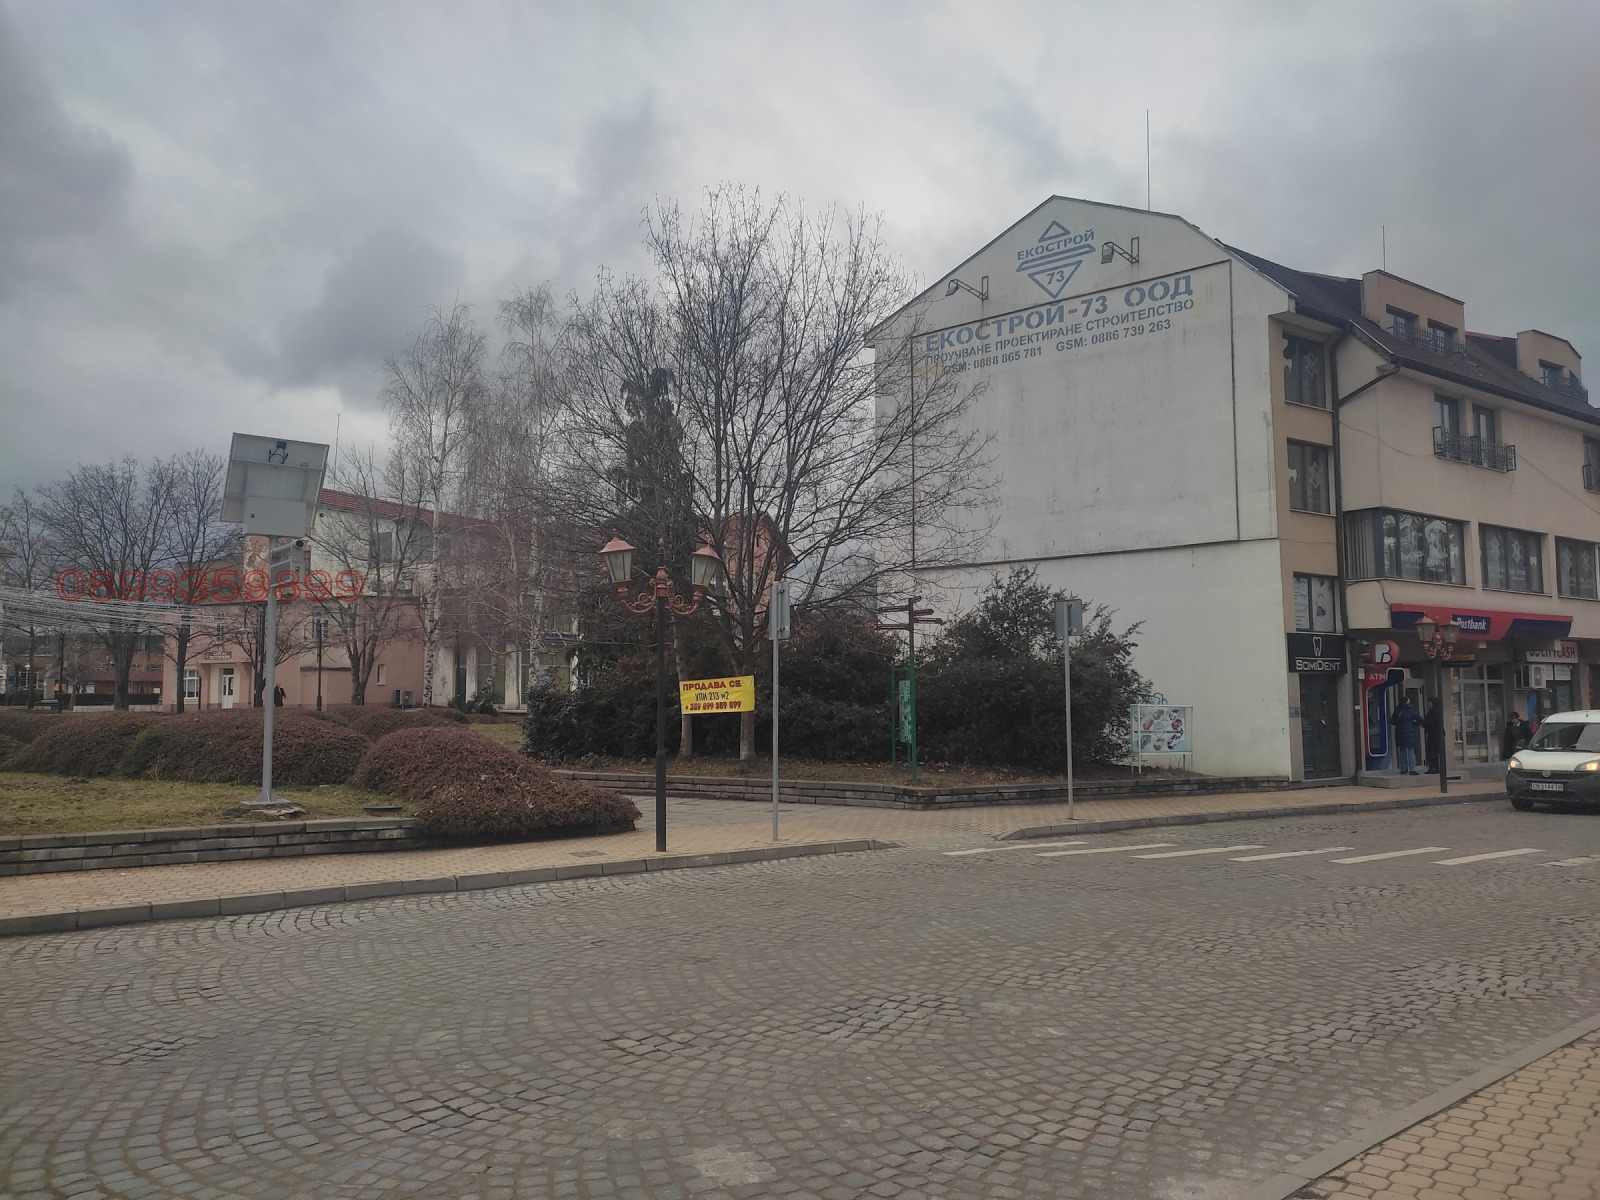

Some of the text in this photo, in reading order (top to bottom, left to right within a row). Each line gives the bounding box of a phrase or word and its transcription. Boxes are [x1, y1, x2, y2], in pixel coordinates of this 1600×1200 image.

[1017, 228, 1095, 260] ЕКОСТРОЙ
[1046, 270, 1065, 285] 73
[1124, 274, 1194, 307] ООД
[995, 323, 1082, 351] ПРОЕКТИРАНЕ
[1086, 299, 1194, 332] СТРОИТЕЛСТВО
[1056, 318, 1171, 352] GSM: 0886 739 263
[974, 356, 999, 369] 0888
[1002, 351, 1021, 364] 865
[1024, 346, 1042, 359] 781
[683, 680, 741, 691] ПРОДАВА СЕ
